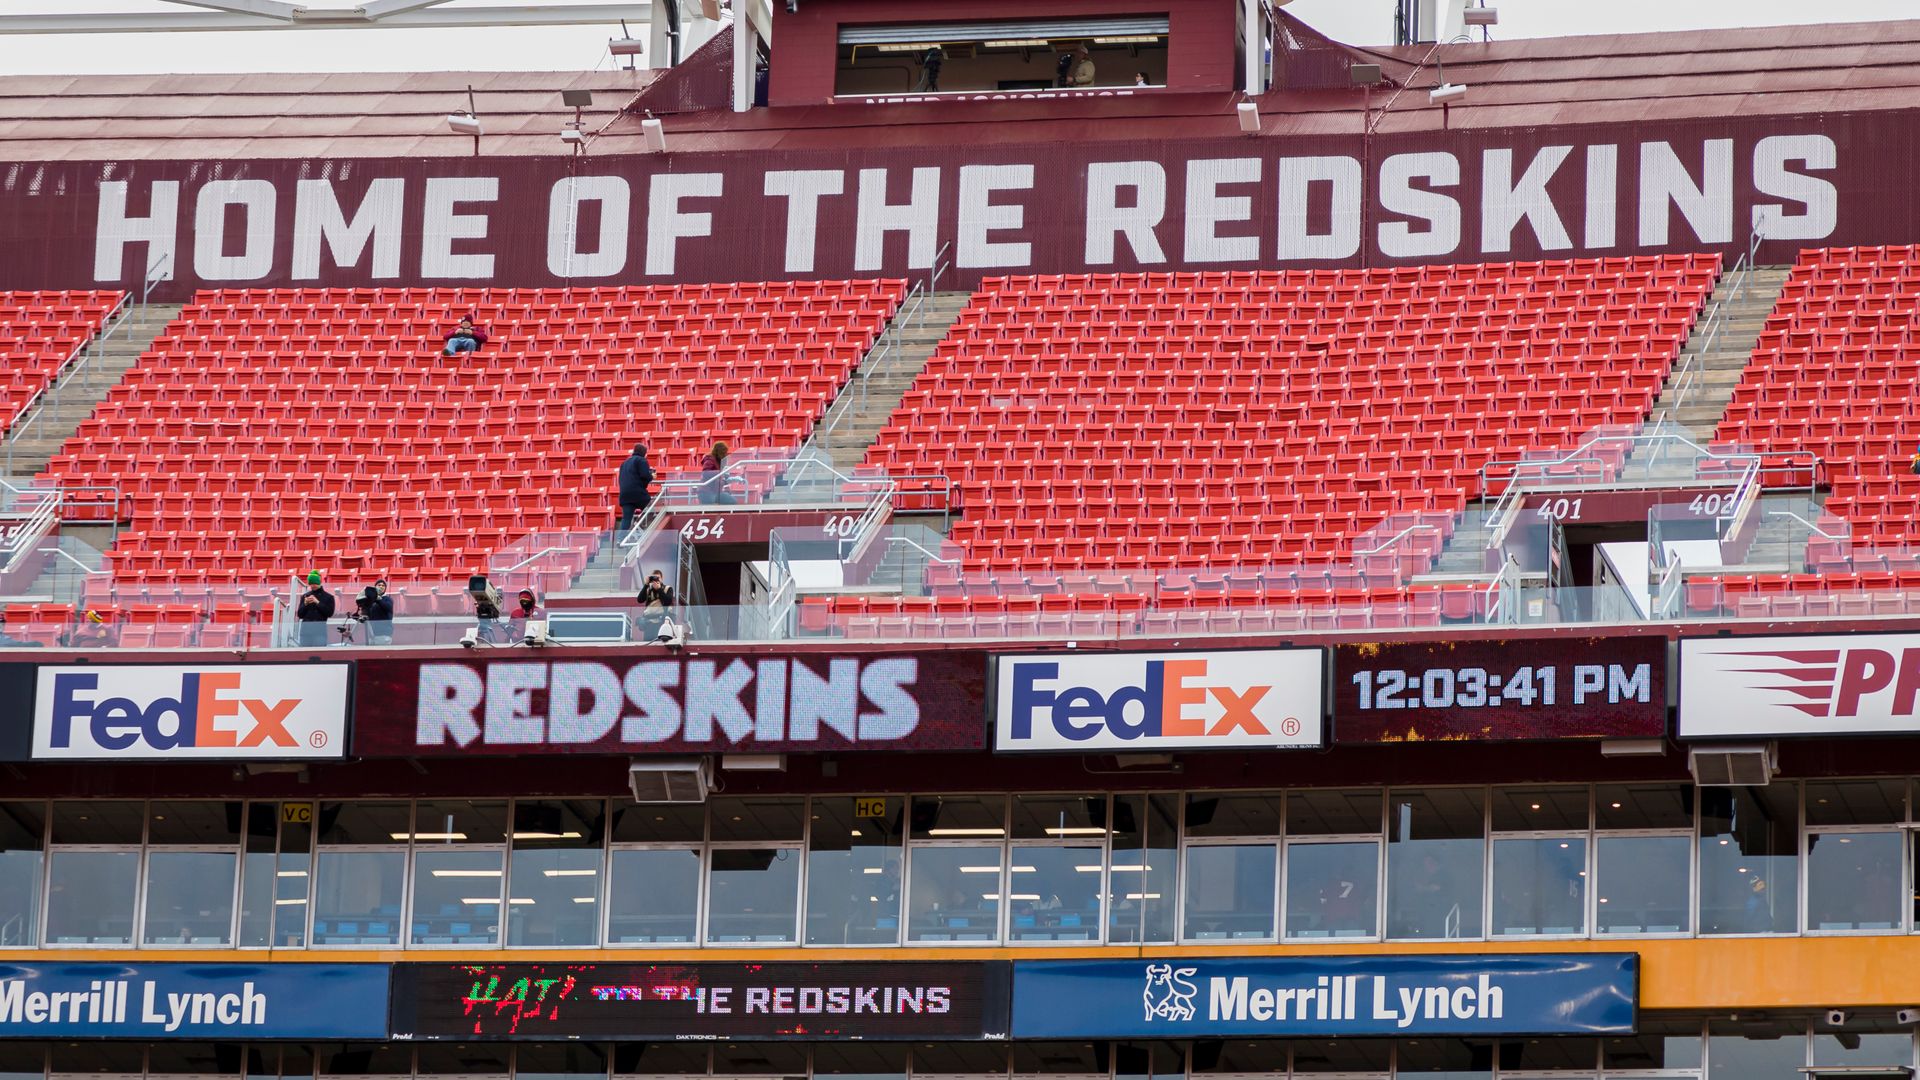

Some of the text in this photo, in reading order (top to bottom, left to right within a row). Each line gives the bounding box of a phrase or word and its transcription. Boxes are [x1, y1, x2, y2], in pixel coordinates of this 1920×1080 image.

[94, 134, 1838, 281] HOME OF THE REDSKINS
[680, 517, 725, 540] 454
[1537, 498, 1582, 520] 401
[415, 657, 921, 749] REDSKINS
[1010, 659, 1273, 741] FedEx
[1352, 663, 1652, 709] 12:03:41 PM
[50, 672, 303, 750] FedEx
[285, 807, 310, 821] VC
[857, 802, 884, 816] HC
[1339, 881, 1354, 898] 7
[0, 980, 267, 1032] Merrill Lynch
[745, 986, 950, 1014] REDSKINS
[1208, 974, 1503, 1028] Merrill Lynch
